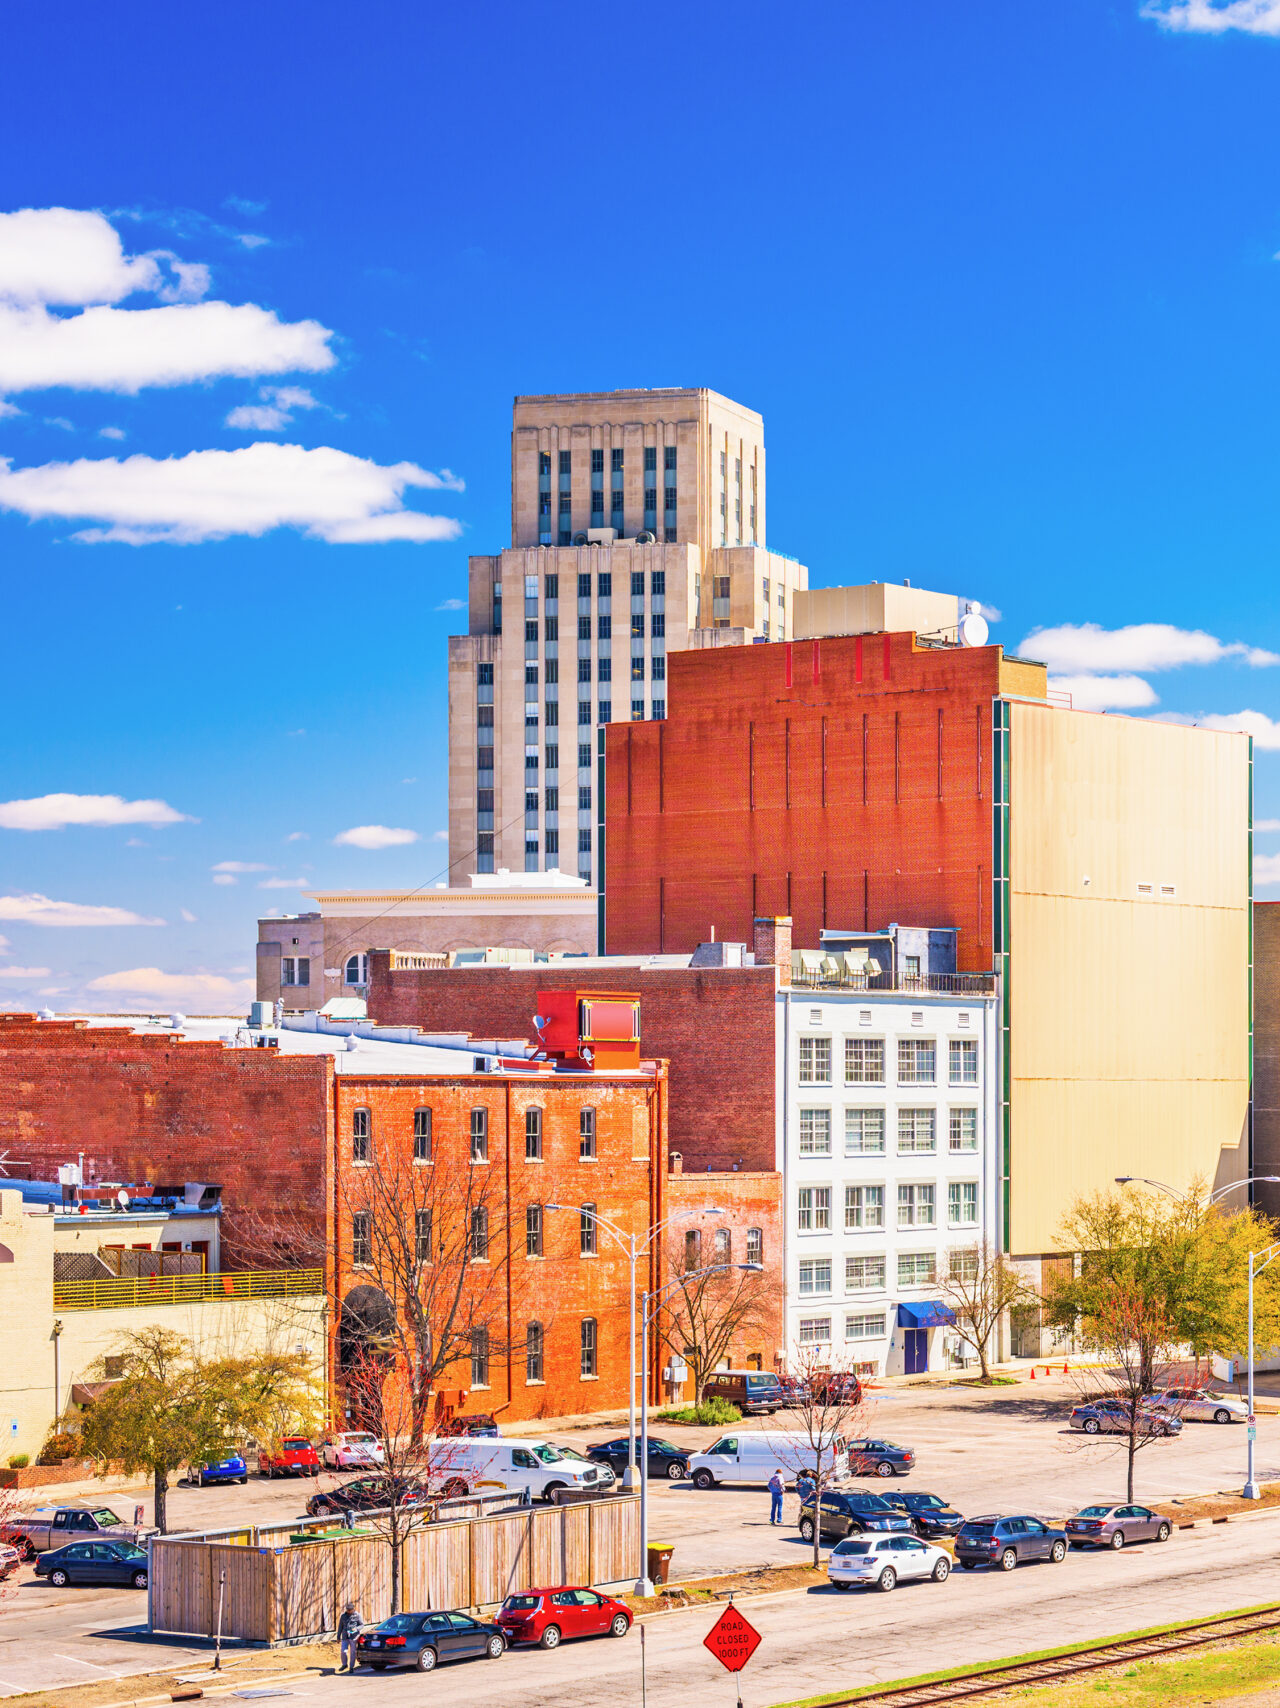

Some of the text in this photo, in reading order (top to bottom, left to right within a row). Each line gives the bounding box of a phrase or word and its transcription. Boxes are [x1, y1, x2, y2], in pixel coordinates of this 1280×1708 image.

[721, 1622, 743, 1631] ROAD
[717, 1635, 749, 1645] CLOSED
[719, 1648, 749, 1658] 1000 FT
